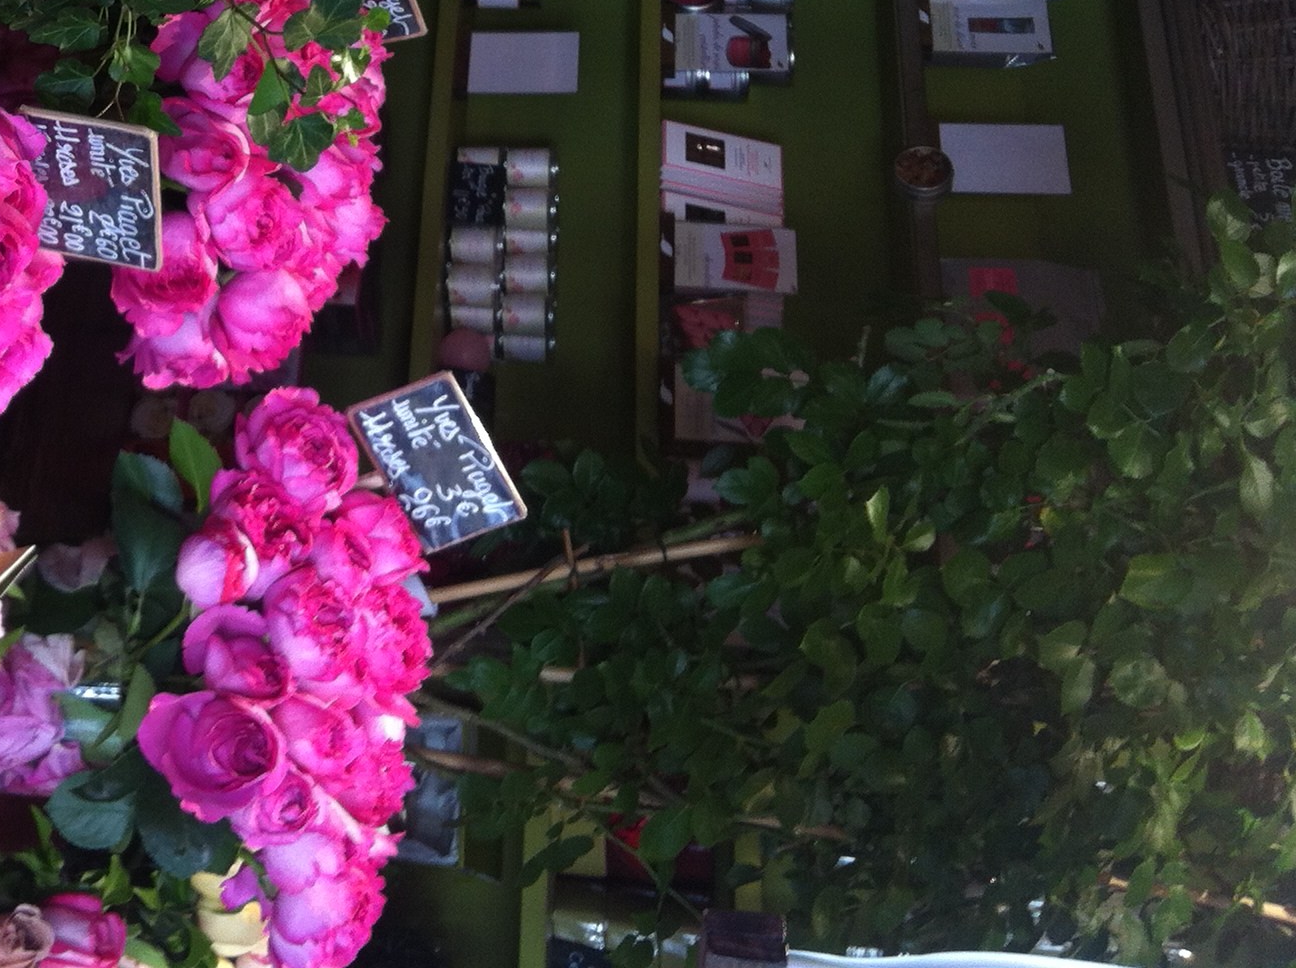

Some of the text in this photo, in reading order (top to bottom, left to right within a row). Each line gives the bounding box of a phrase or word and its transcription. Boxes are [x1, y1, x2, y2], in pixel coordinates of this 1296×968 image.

[88, 128, 116, 187] unité
[106, 143, 154, 269] Yves Piaget
[392, 399, 441, 450] unité
[413, 394, 514, 522] Yves Piaget
